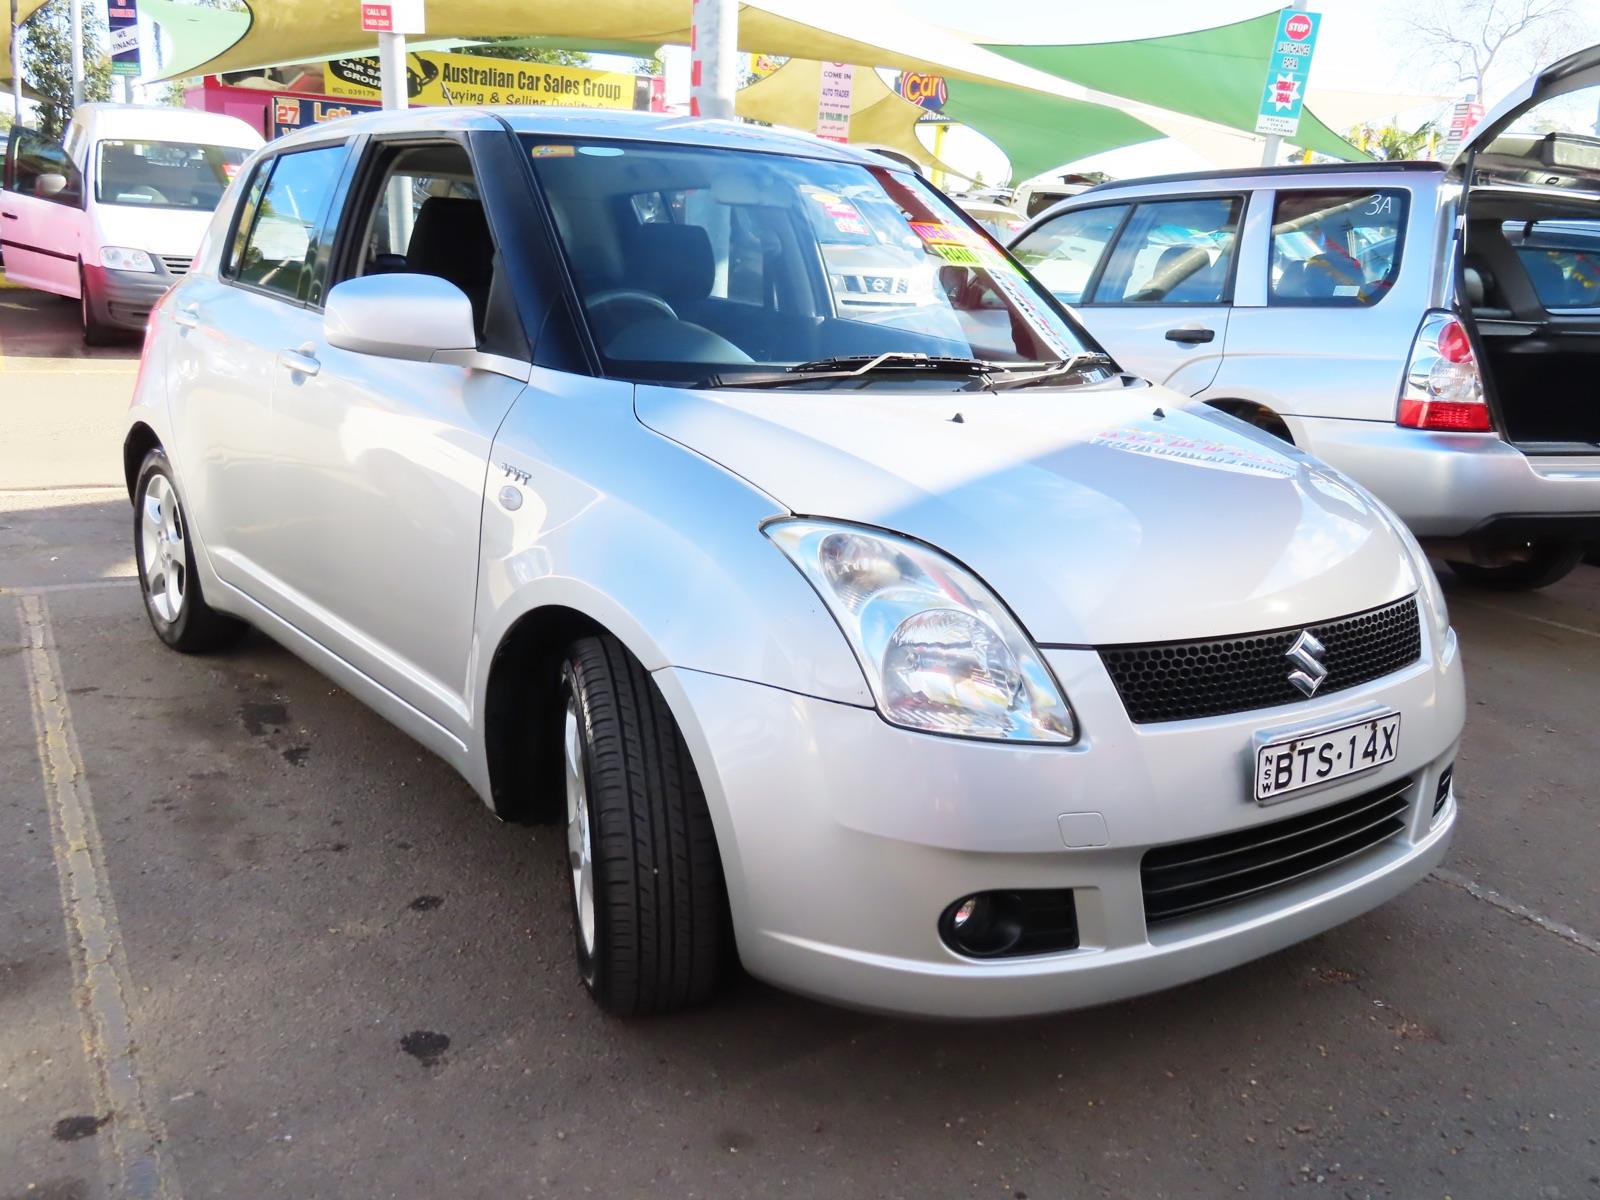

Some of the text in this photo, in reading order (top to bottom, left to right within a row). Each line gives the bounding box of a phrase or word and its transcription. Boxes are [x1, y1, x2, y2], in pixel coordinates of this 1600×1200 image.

[1287, 23, 1309, 32] STOP
[112, 37, 138, 51] FINANCE
[339, 60, 382, 78] CAR SA
[823, 71, 843, 79] COME
[442, 63, 515, 88] Australian
[517, 71, 541, 91] Car
[543, 74, 580, 94] Sales
[583, 78, 622, 101] Group
[489, 92, 501, 104] &
[277, 105, 299, 124] 27
[1364, 193, 1392, 216] 3A
